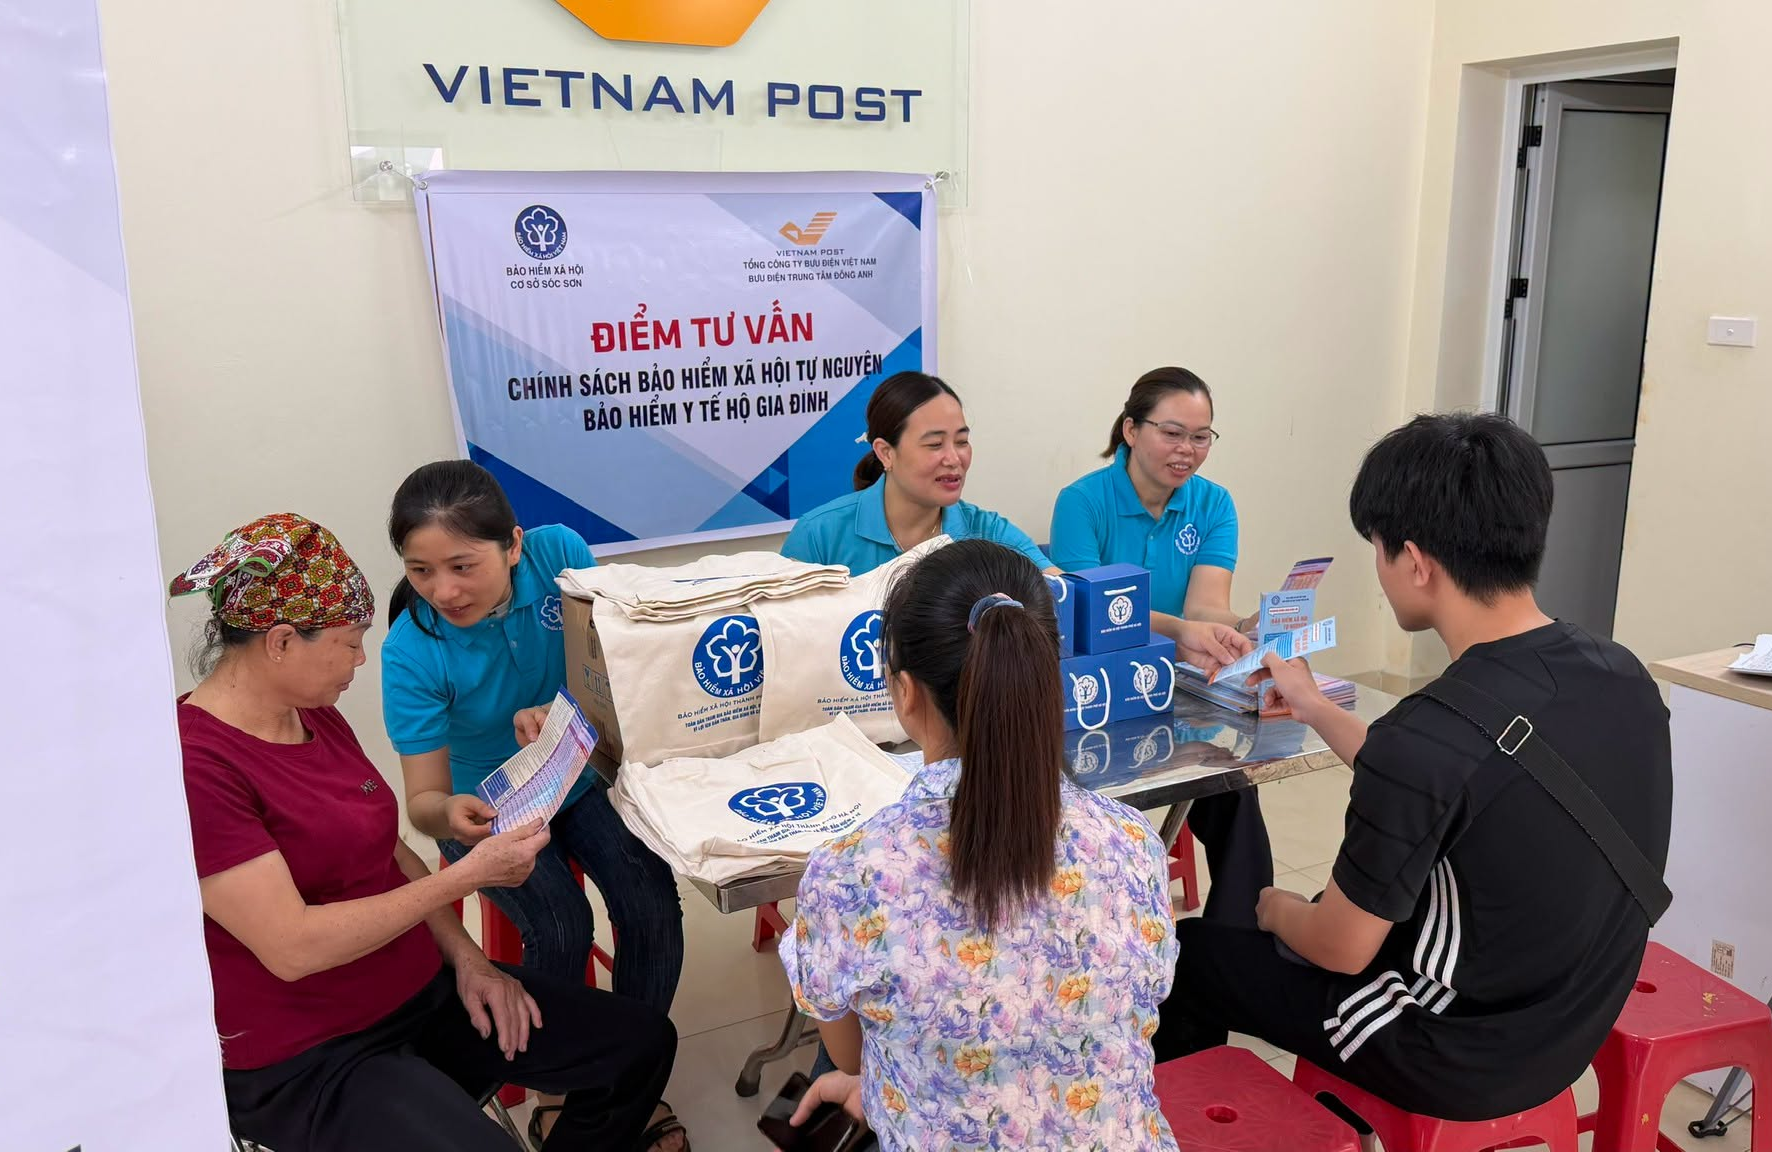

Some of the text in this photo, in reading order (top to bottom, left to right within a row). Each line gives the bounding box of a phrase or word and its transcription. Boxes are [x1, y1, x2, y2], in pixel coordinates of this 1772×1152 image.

[422, 63, 922, 123] VIETNAM POST
[743, 257, 877, 270] TỔNG CÔNG TY BƯU ĐIỆN VIỆT NAM
[776, 248, 845, 257] VIETNAM POST
[506, 262, 584, 276] BẢO HIỂM XÃ HỘI
[748, 270, 873, 283] BƯU ĐIỆN TRUNG TÂM ĐÔNG ANH
[526, 277, 540, 289] SỞ
[541, 278, 561, 289] SÓC
[563, 278, 582, 288] SƠN
[591, 299, 813, 353] ĐIỂM TƯ VẤN
[508, 350, 883, 401] CHÍNH SÁCH BẢO HIỂM XÃ HỘI TỰ NGUYỆN
[583, 401, 622, 431] BẢO
[629, 394, 677, 428] HIỂM
[682, 401, 694, 423] Y
[699, 391, 722, 422] TẾ
[726, 392, 751, 424] HỘ
[756, 394, 785, 418] GIA
[694, 661, 706, 680] BẢO
[702, 678, 722, 696] HIỂM
[722, 687, 734, 697] XÃ
[737, 681, 754, 694] HỘI
[842, 655, 850, 672] BẢO
[846, 672, 864, 689] HIỂM
[863, 681, 875, 690] XÃ
[678, 711, 693, 720] BẢO
[694, 705, 709, 716] HIỂM
[709, 703, 719, 711] XÃ
[719, 701, 731, 709] HỘI
[733, 695, 755, 705] THÀNH
[833, 695, 849, 704] HIỂM
[860, 694, 872, 702] HỘI
